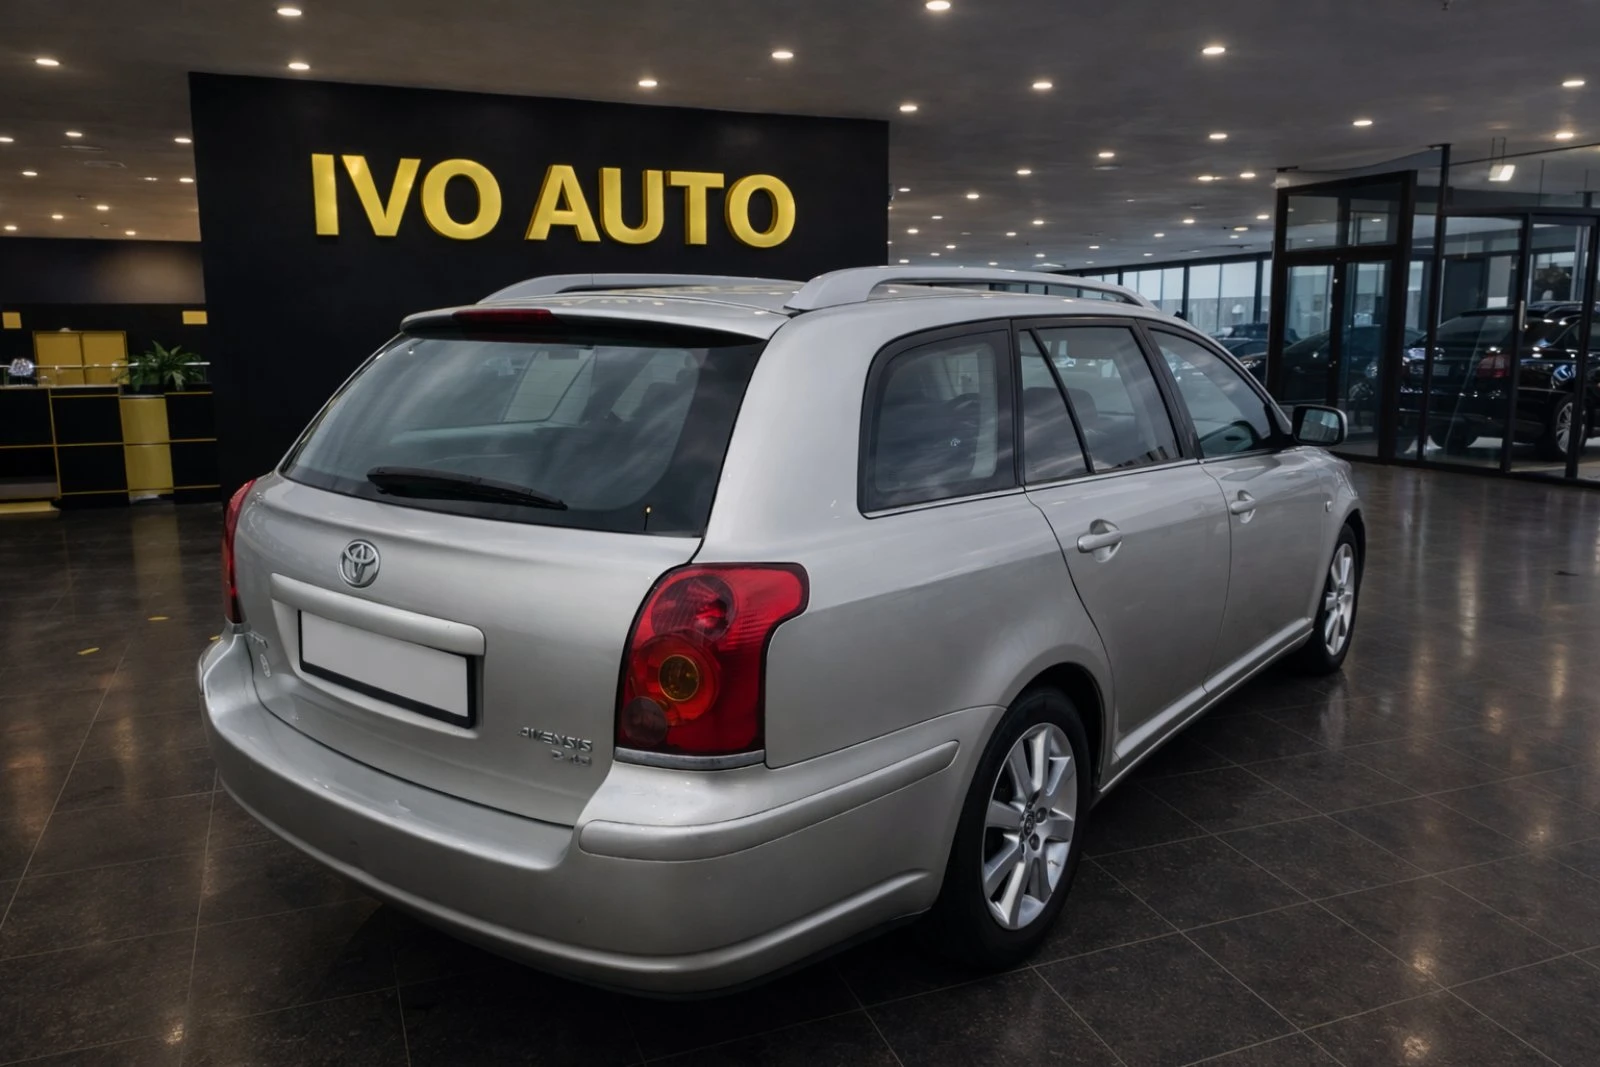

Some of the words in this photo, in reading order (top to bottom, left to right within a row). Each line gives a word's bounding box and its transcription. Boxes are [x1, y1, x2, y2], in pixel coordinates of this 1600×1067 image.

[311, 153, 502, 240] IVO
[524, 163, 796, 248] AUTO
[519, 727, 593, 752] AVENSIS
